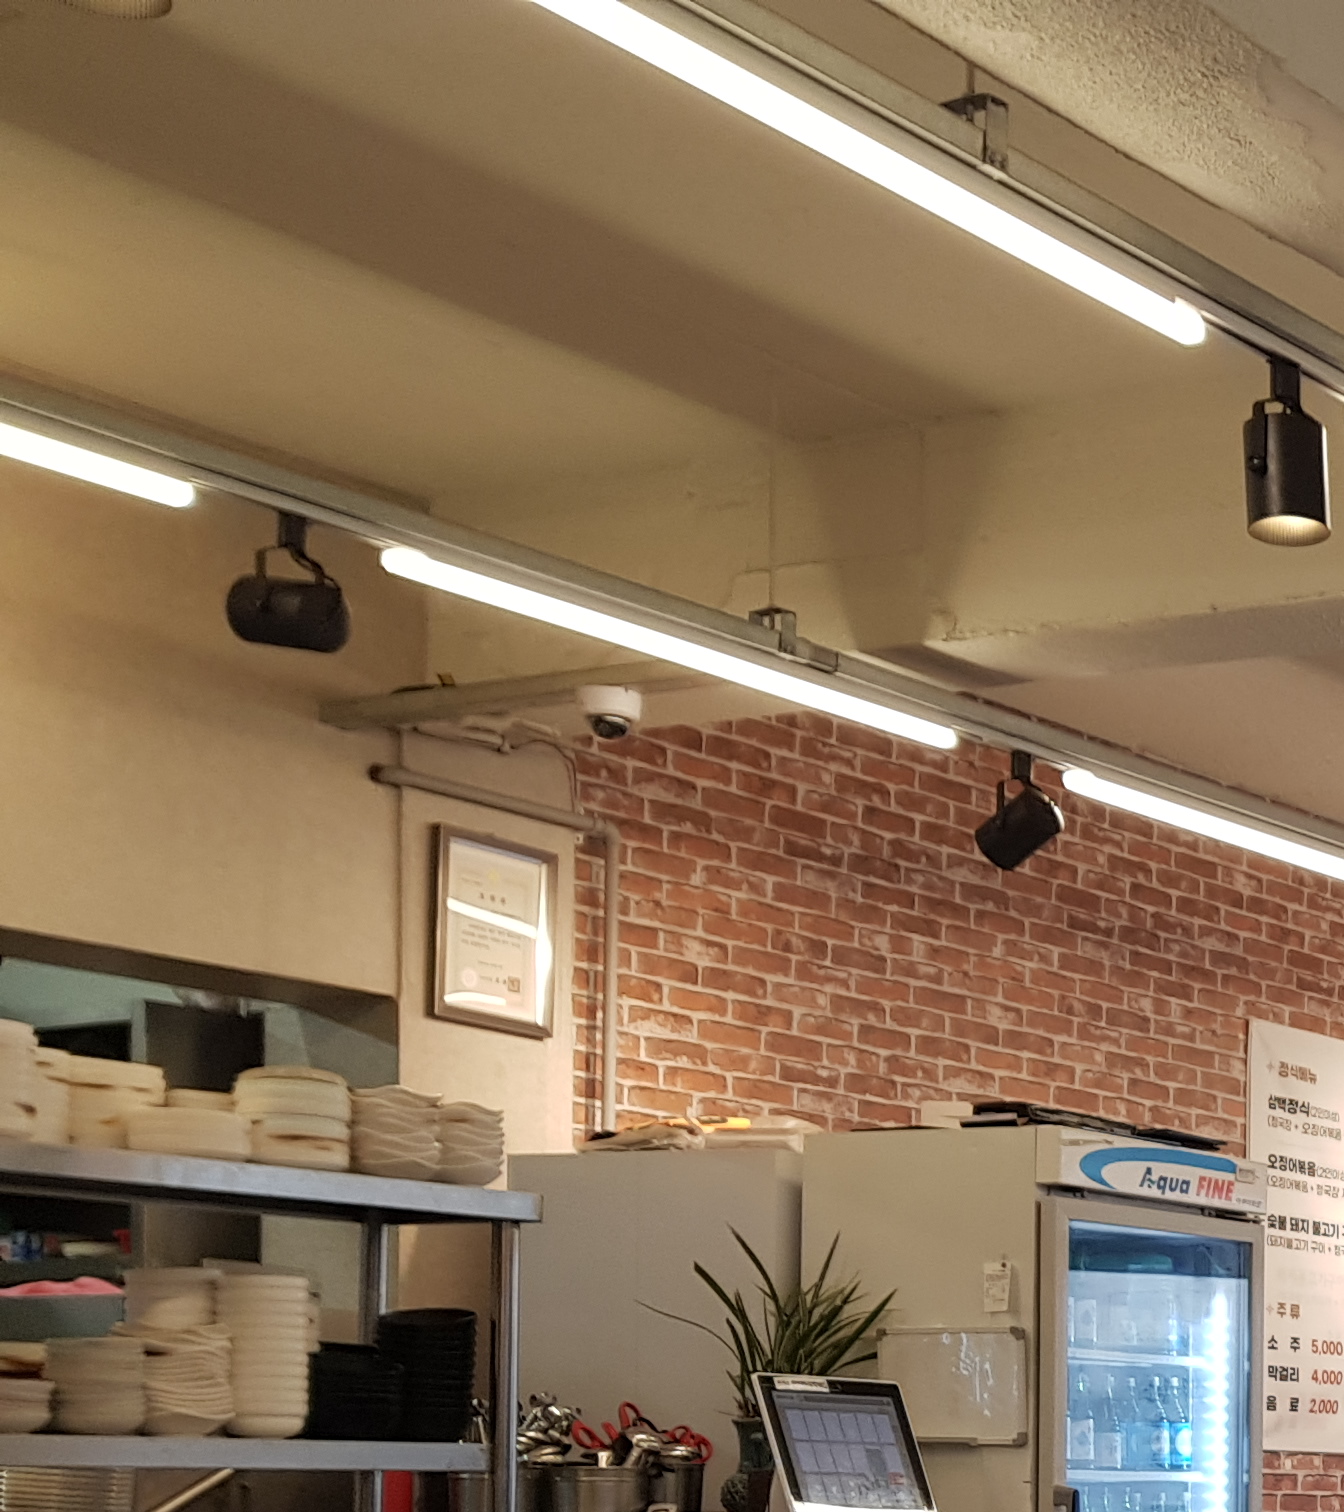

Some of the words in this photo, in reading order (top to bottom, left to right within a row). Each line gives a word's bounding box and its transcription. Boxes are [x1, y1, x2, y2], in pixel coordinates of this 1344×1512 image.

[1197, 1175, 1234, 1200] FINE
[1290, 1217, 1309, 1234] 돼지
[1313, 1220, 1339, 1240] 불고기
[1312, 1339, 1343, 1356] 5,000
[1268, 1365, 1299, 1382] 막걸리
[1312, 1369, 1343, 1385] 4,000
[1309, 1399, 1338, 1415] 2,000
